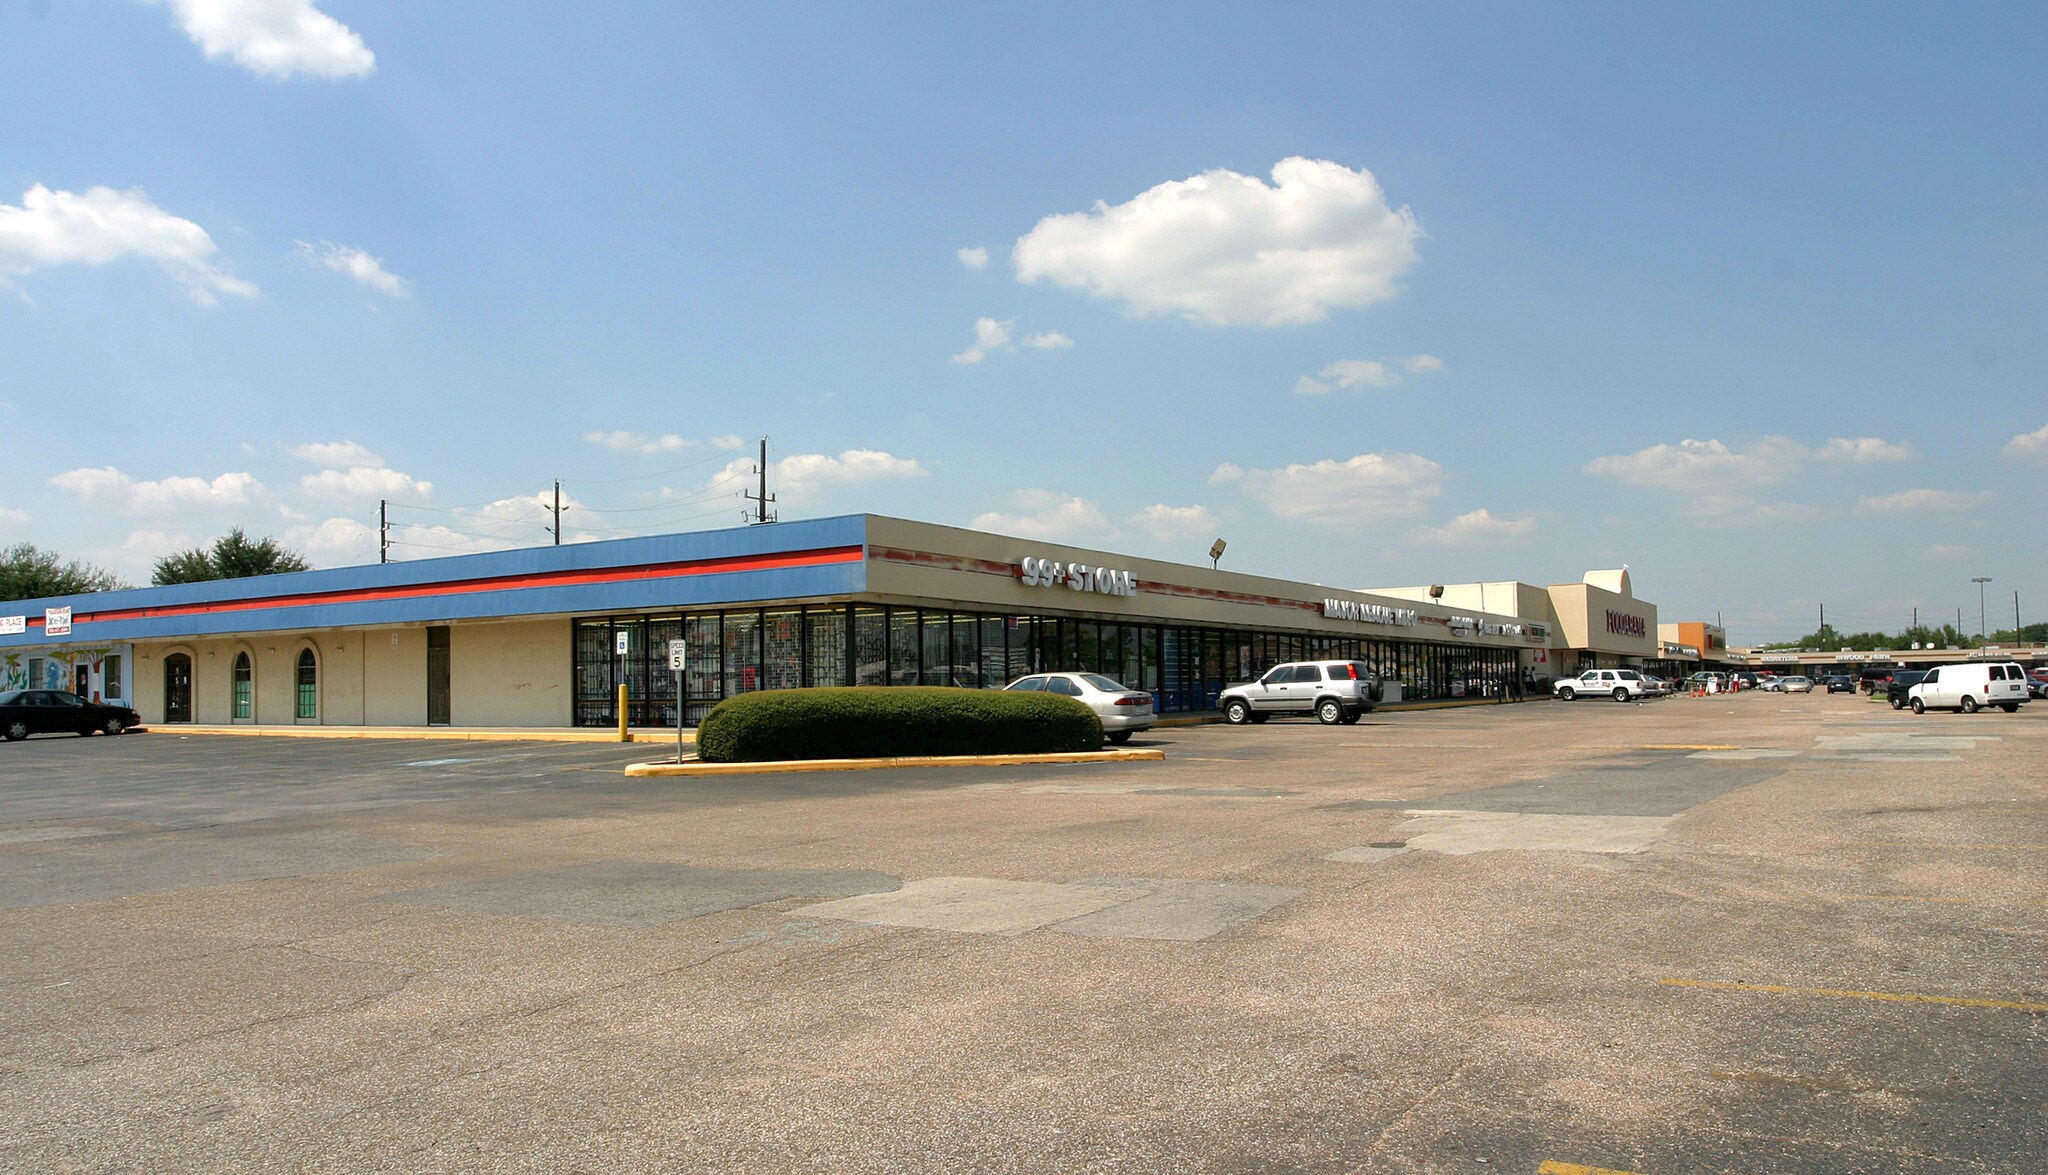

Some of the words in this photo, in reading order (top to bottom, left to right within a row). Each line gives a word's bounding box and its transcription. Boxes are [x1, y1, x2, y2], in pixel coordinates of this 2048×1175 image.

[1067, 563, 1137, 597] STORE
[1324, 599, 1360, 621] MAJOR
[6, 618, 22, 627] PLACE
[674, 657, 681, 668] 5
